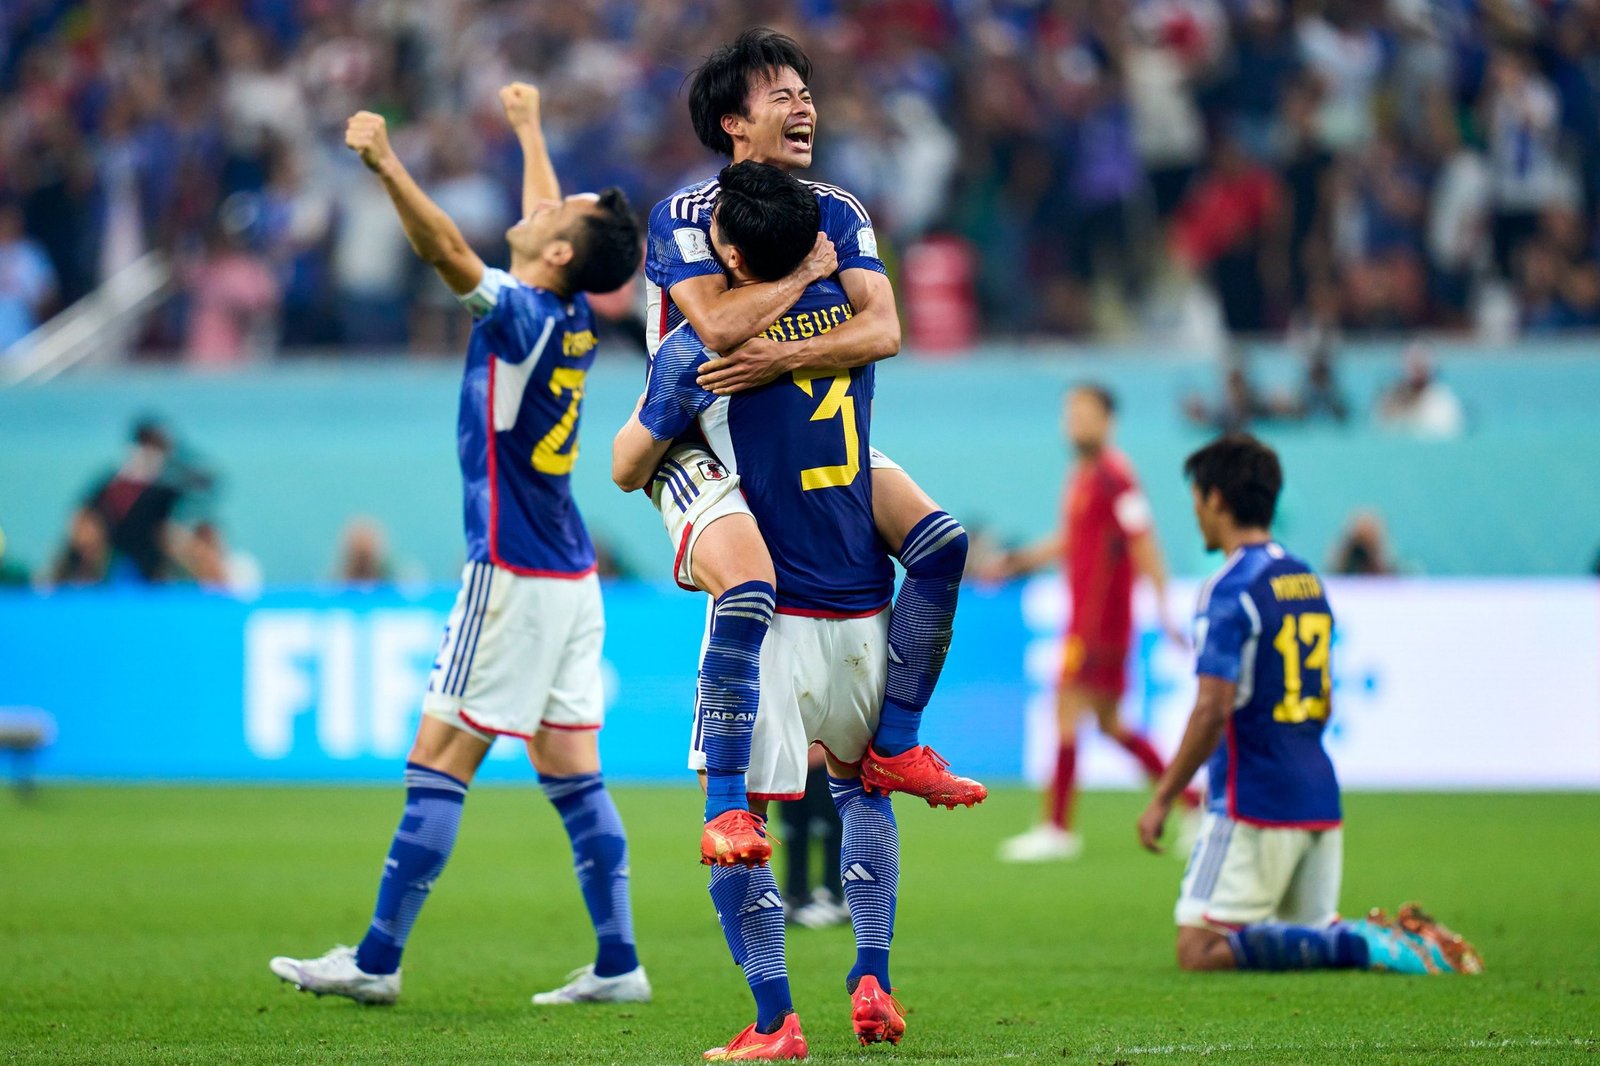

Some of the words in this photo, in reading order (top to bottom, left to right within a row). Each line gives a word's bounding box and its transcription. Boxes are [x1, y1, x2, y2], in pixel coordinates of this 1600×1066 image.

[759, 303, 853, 342] NIGUCH
[792, 367, 860, 491] 3
[1273, 612, 1332, 723] 13
[703, 710, 754, 721] JAPAN
